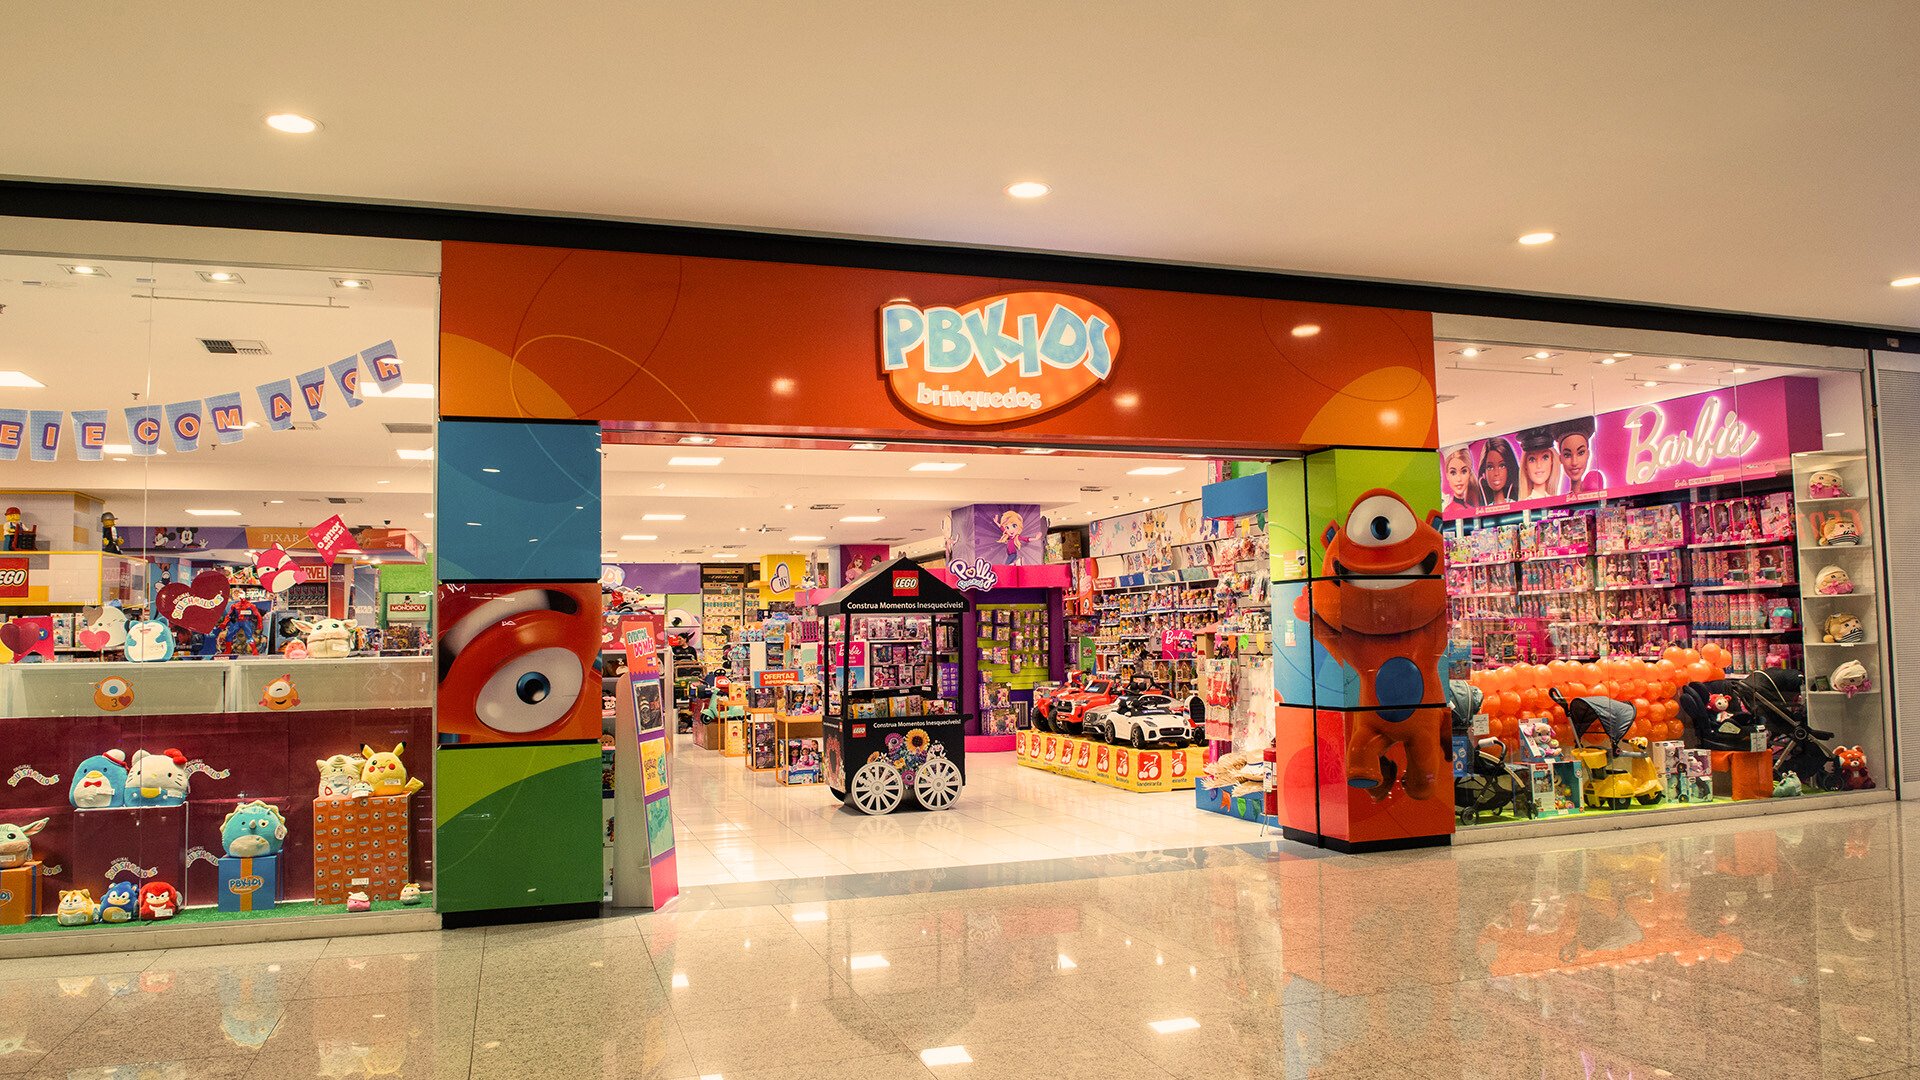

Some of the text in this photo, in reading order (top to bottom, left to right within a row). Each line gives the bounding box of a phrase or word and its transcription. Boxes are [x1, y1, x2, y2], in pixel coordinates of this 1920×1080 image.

[883, 298, 1112, 380] PBKIDS
[917, 382, 1042, 411] brinquedos
[134, 404, 243, 445] COM
[1625, 396, 1759, 485] Barbie
[263, 533, 299, 541] PIXAR
[322, 521, 341, 543] amor
[895, 578, 917, 588] LEGO
[950, 558, 996, 590] Polly
[763, 672, 795, 680] OFERTAS
[898, 720, 925, 728] Momentos
